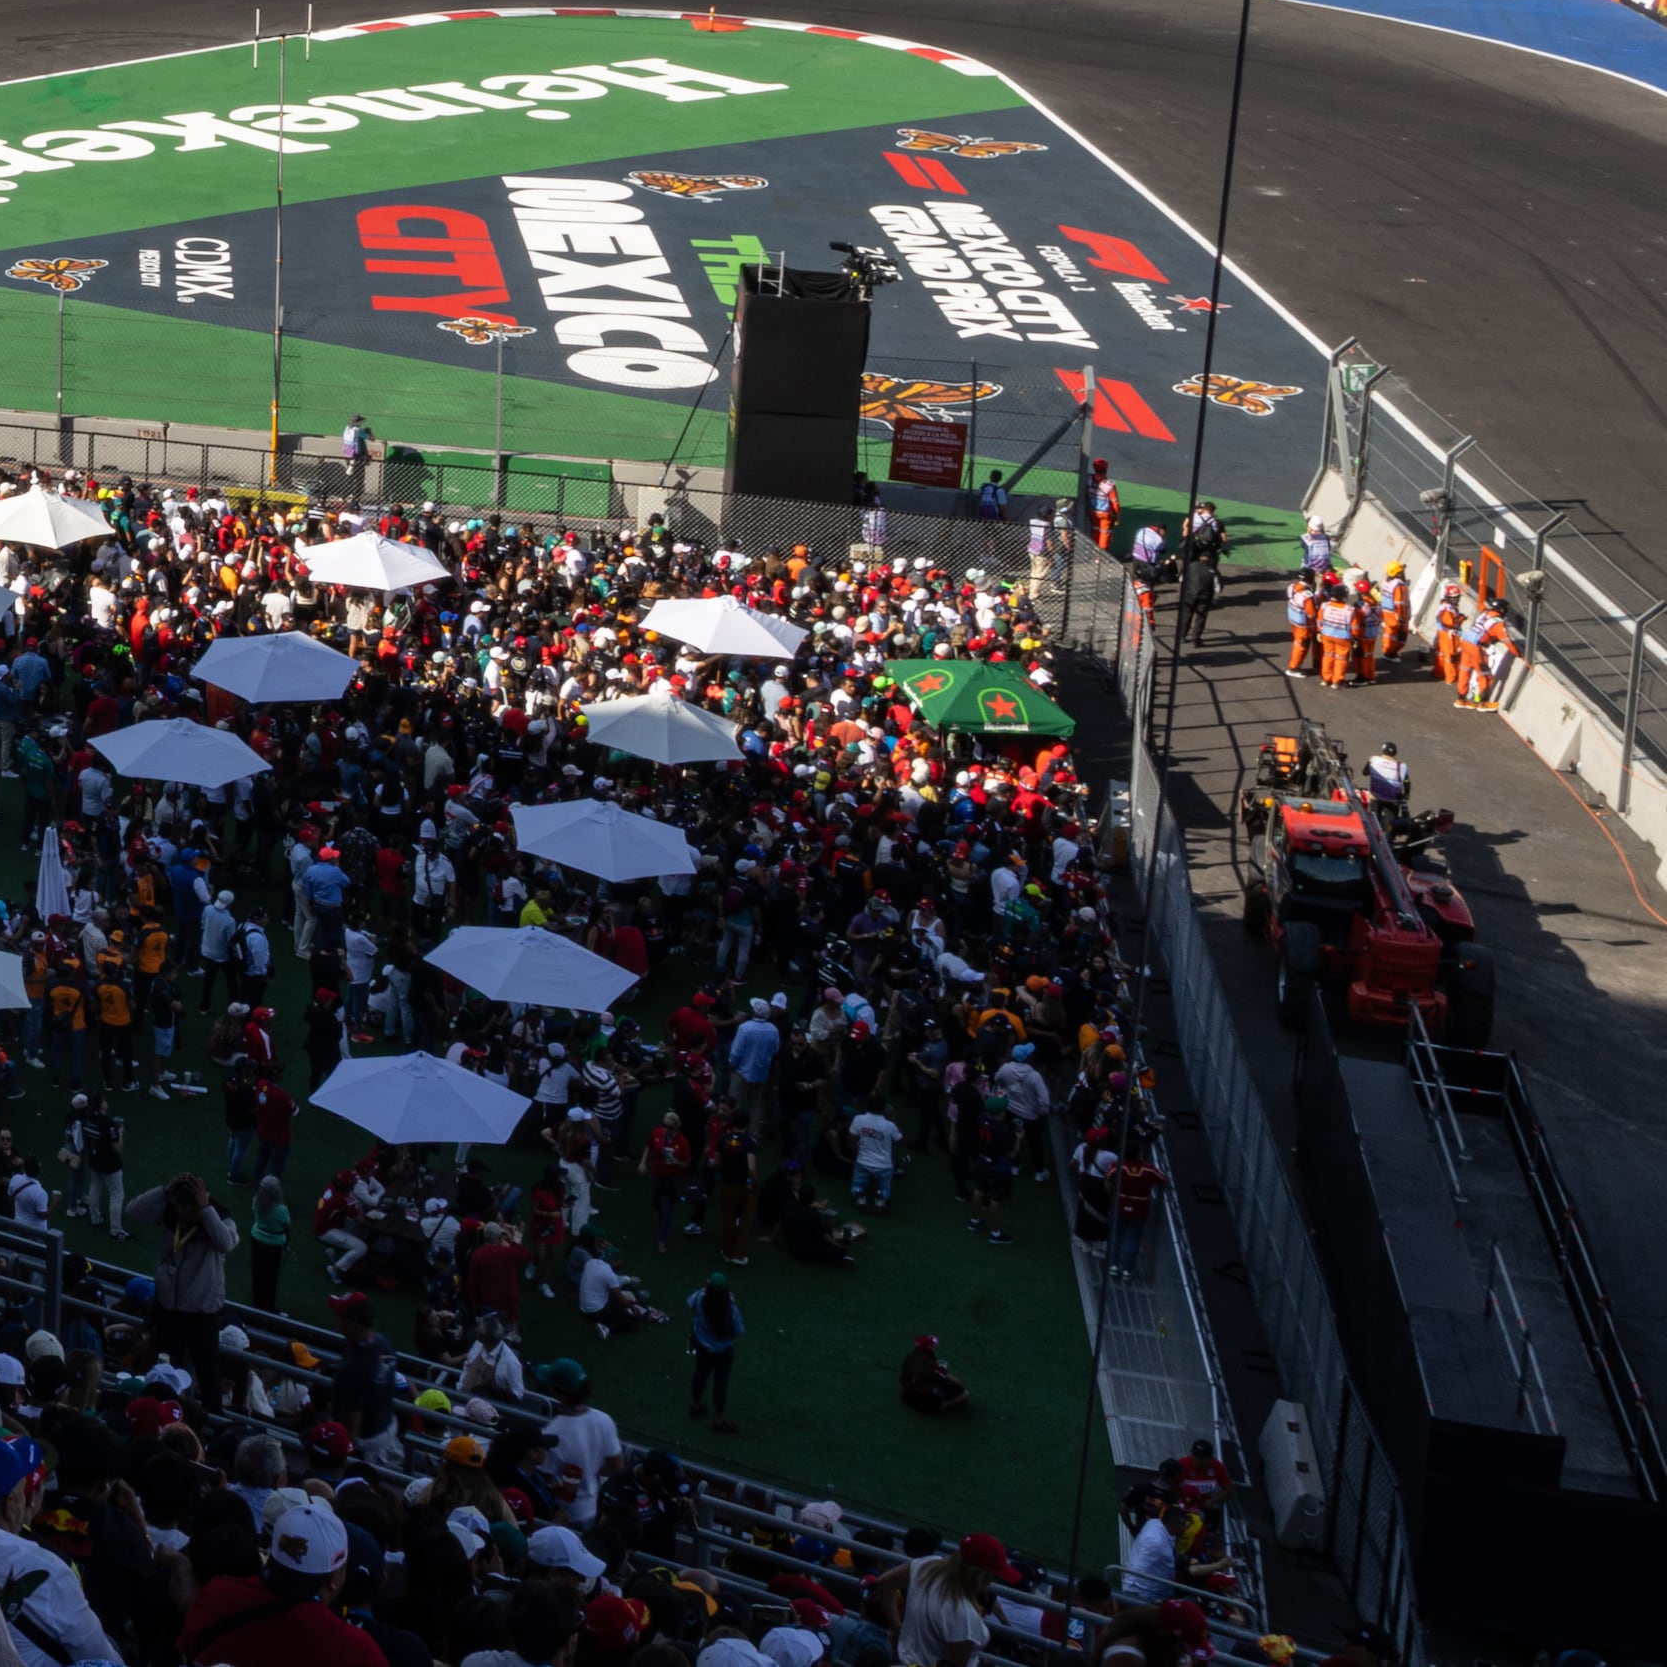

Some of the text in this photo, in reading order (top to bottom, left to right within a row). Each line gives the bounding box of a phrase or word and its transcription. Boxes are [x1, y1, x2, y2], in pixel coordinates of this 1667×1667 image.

[174, 237, 234, 300] CDMX
[355, 205, 519, 328] CITY
[502, 176, 719, 389] MEXICO
[868, 204, 1024, 342] GRAND PRIX
[923, 201, 1101, 350] MEXICO CITY
[1036, 244, 1077, 285] FORMULA
[1112, 281, 1175, 331] Heineken
